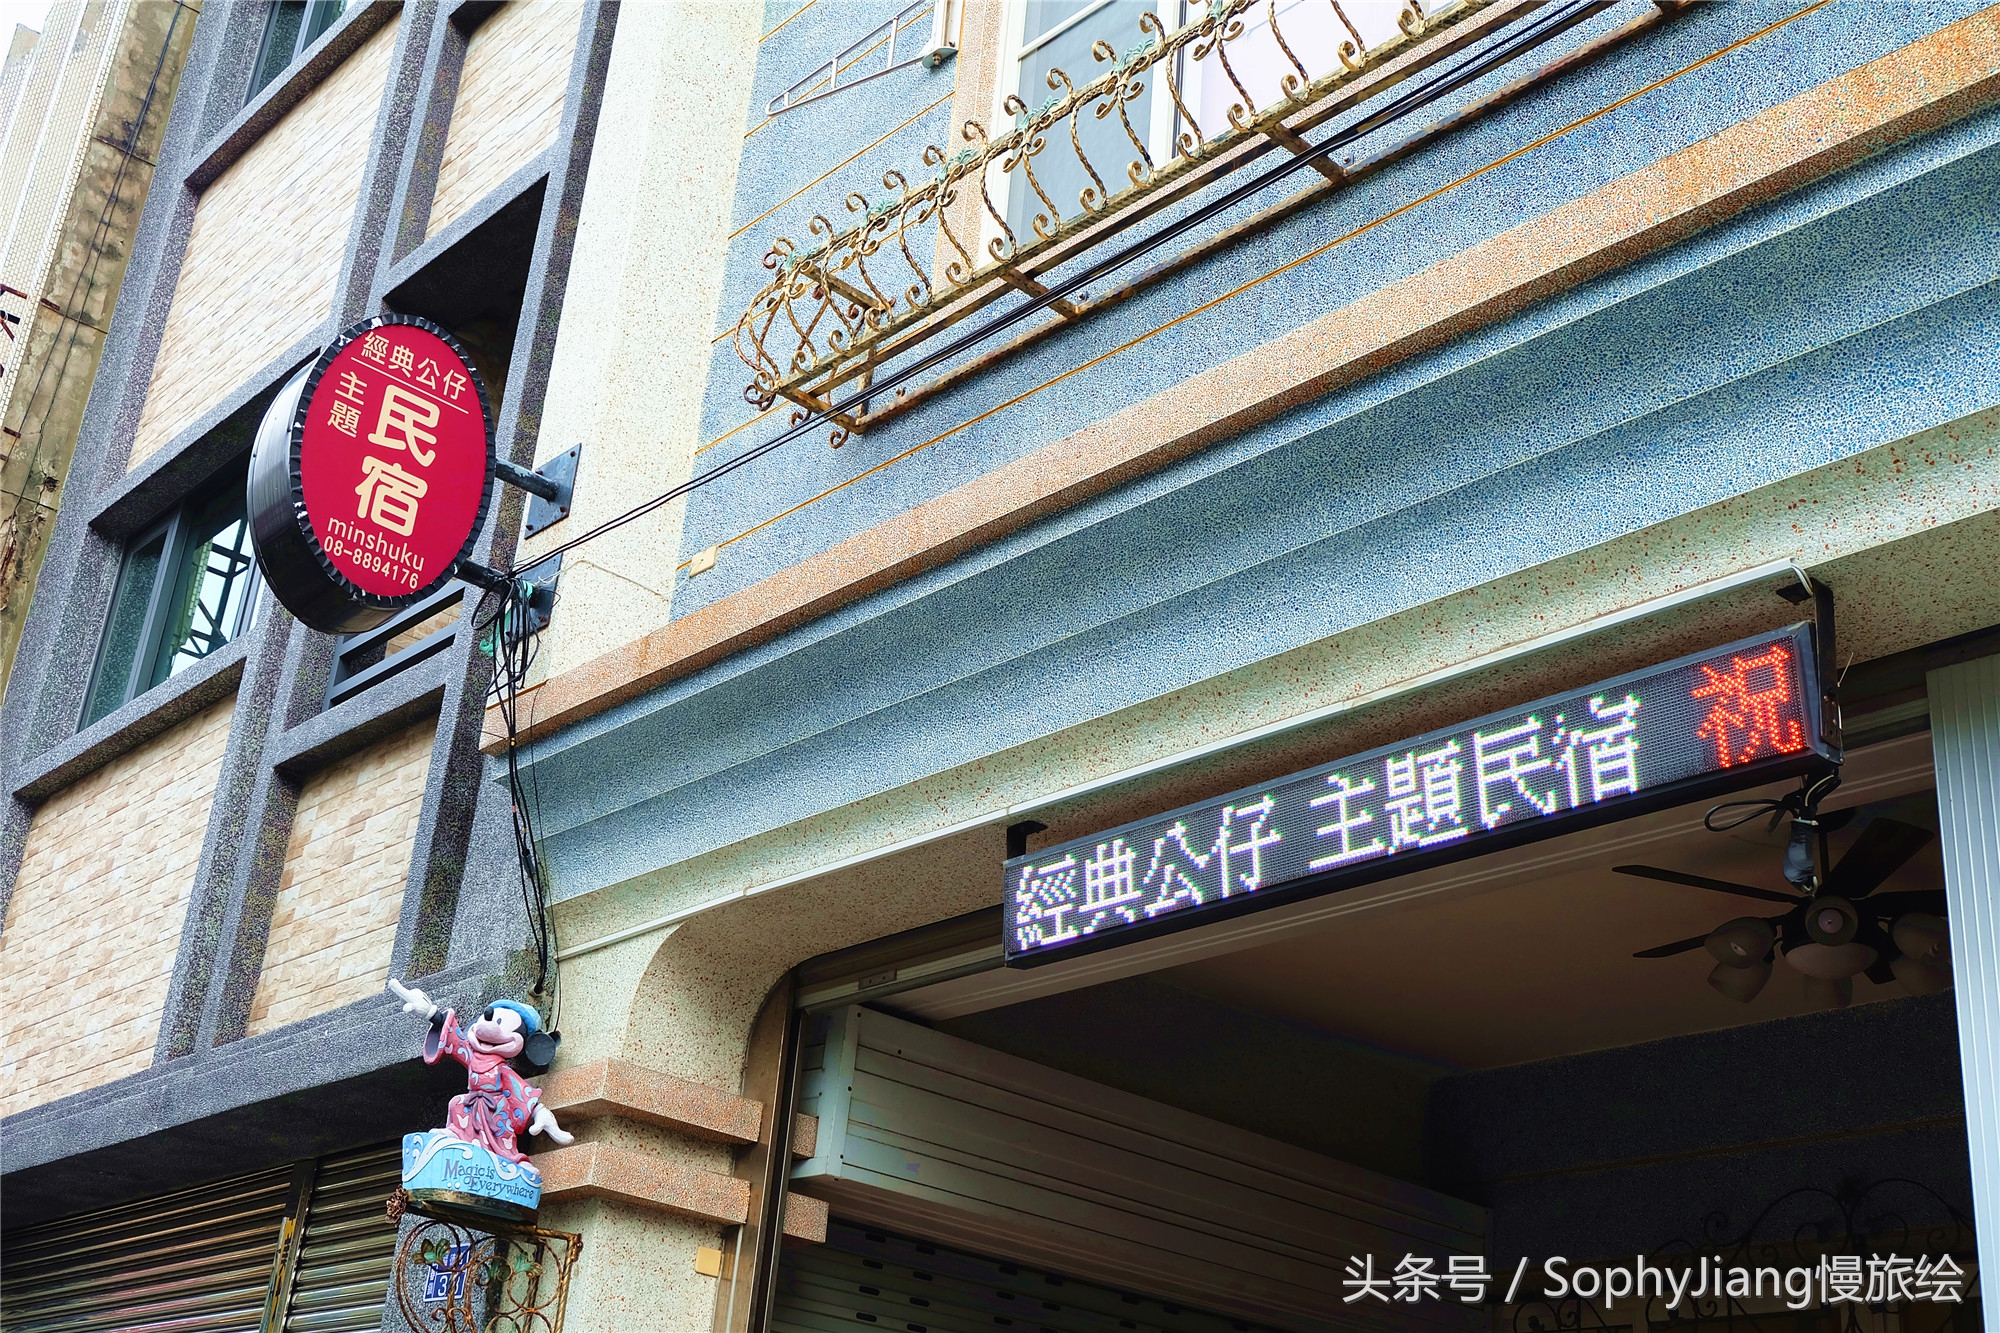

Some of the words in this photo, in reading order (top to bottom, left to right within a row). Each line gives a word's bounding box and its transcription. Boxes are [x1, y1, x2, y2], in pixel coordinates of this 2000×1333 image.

[360, 331, 467, 400] 經典公仔
[327, 371, 367, 438] 主題
[354, 384, 440, 537] 民宿
[323, 535, 419, 589] 08-8894176
[327, 517, 424, 571] minshuku
[1016, 794, 1283, 950] 經典公仔
[1309, 694, 1641, 871] 主題民宿
[1691, 645, 1804, 768] 祝
[441, 1158, 485, 1185] Magic
[486, 1166, 496, 1180] is
[468, 1176, 534, 1200] Everywhere
